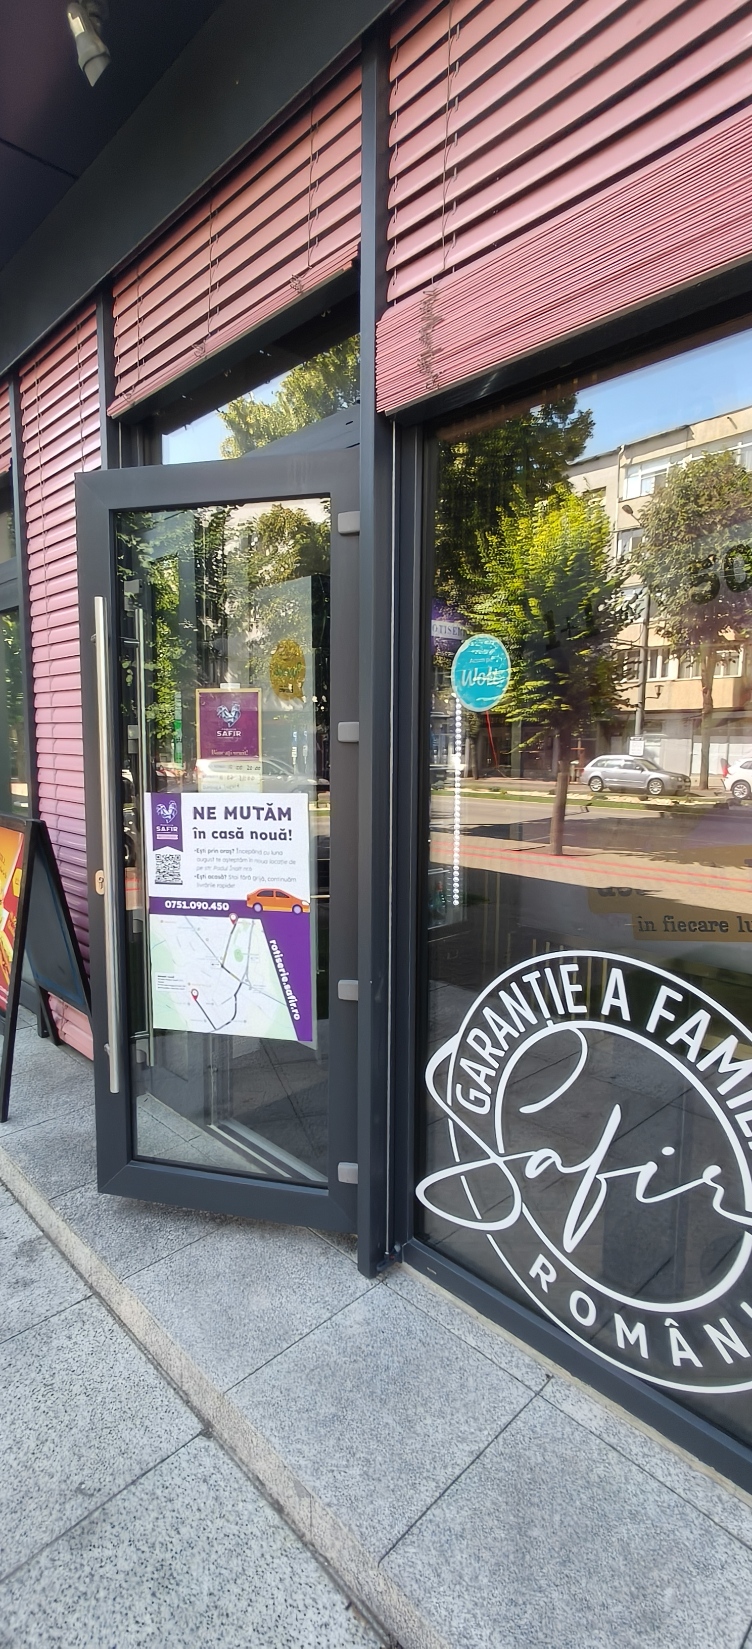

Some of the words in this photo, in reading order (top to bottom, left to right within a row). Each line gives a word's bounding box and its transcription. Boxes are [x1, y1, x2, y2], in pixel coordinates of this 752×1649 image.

[432, 624, 467, 637] OTISERI
[461, 667, 499, 687] Wolt
[192, 806, 217, 820] NE
[224, 802, 292, 821] MUTĂM
[192, 826, 206, 840] în
[211, 826, 244, 840] casă
[250, 828, 292, 841] nouă!
[164, 899, 230, 911] 0751.090.450
[663, 915, 729, 933] fiecare
[269, 939, 300, 1021] rotiserie.safir.ro
[455, 963, 588, 1116] GARANȚIE
[601, 967, 631, 1022] A
[414, 1024, 752, 1253] Safir
